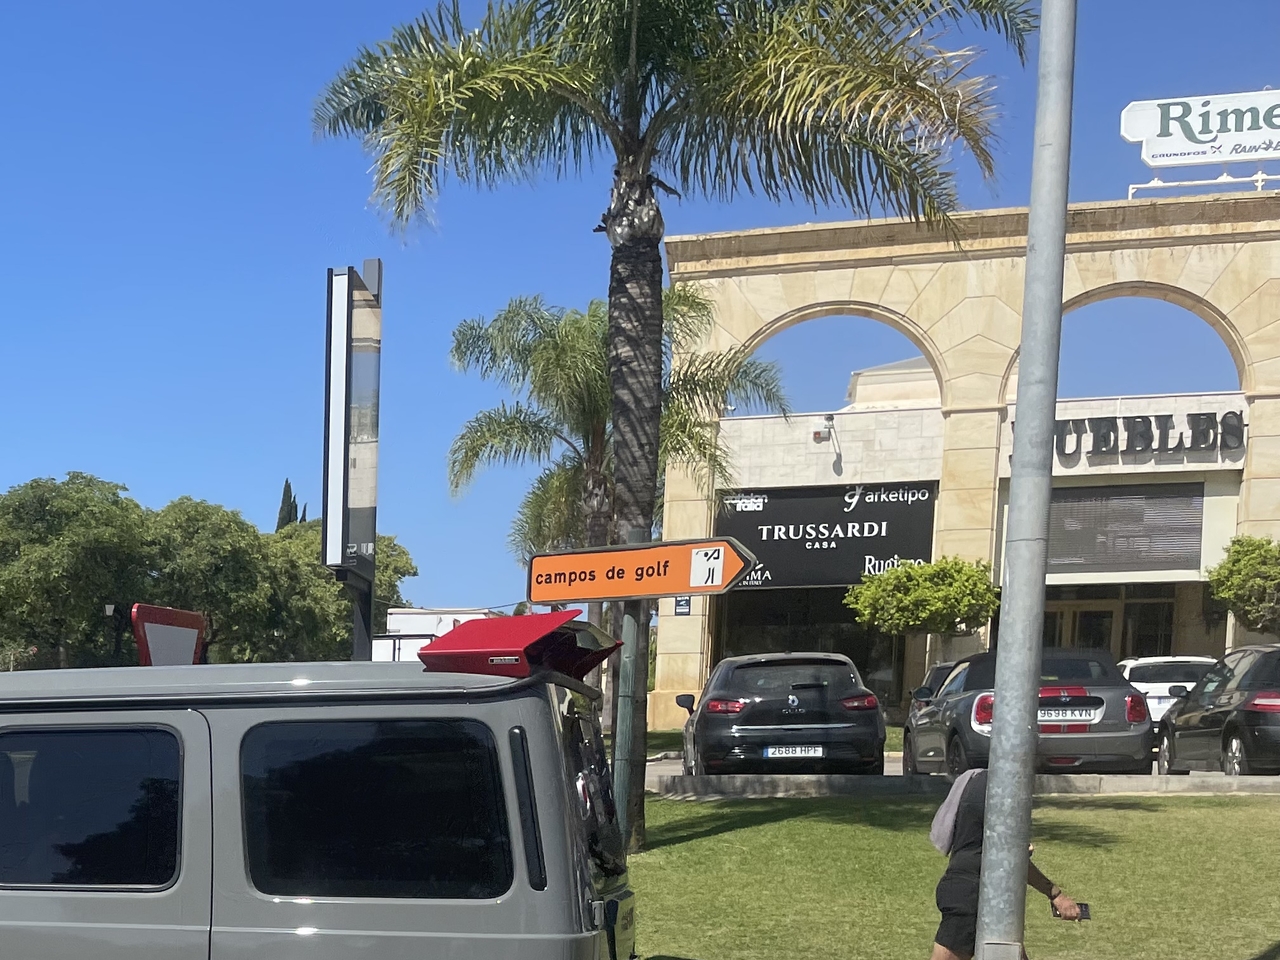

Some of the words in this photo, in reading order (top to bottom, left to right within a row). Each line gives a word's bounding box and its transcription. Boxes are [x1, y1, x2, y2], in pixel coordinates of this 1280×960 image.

[1151, 150, 1208, 159] GRUNDFOS
[1229, 143, 1262, 155] RAIN
[1010, 410, 1245, 456] UEBLES
[864, 487, 929, 505] arketipo
[758, 521, 888, 541] TRUSSARDI
[805, 541, 837, 549] CASA
[535, 569, 596, 587] campos
[606, 566, 625, 580] de
[635, 560, 670, 581] golf
[1040, 709, 1067, 718] 9698
[1071, 709, 1092, 718] KVN
[771, 746, 797, 755] 2688
[800, 746, 819, 755] HPF
